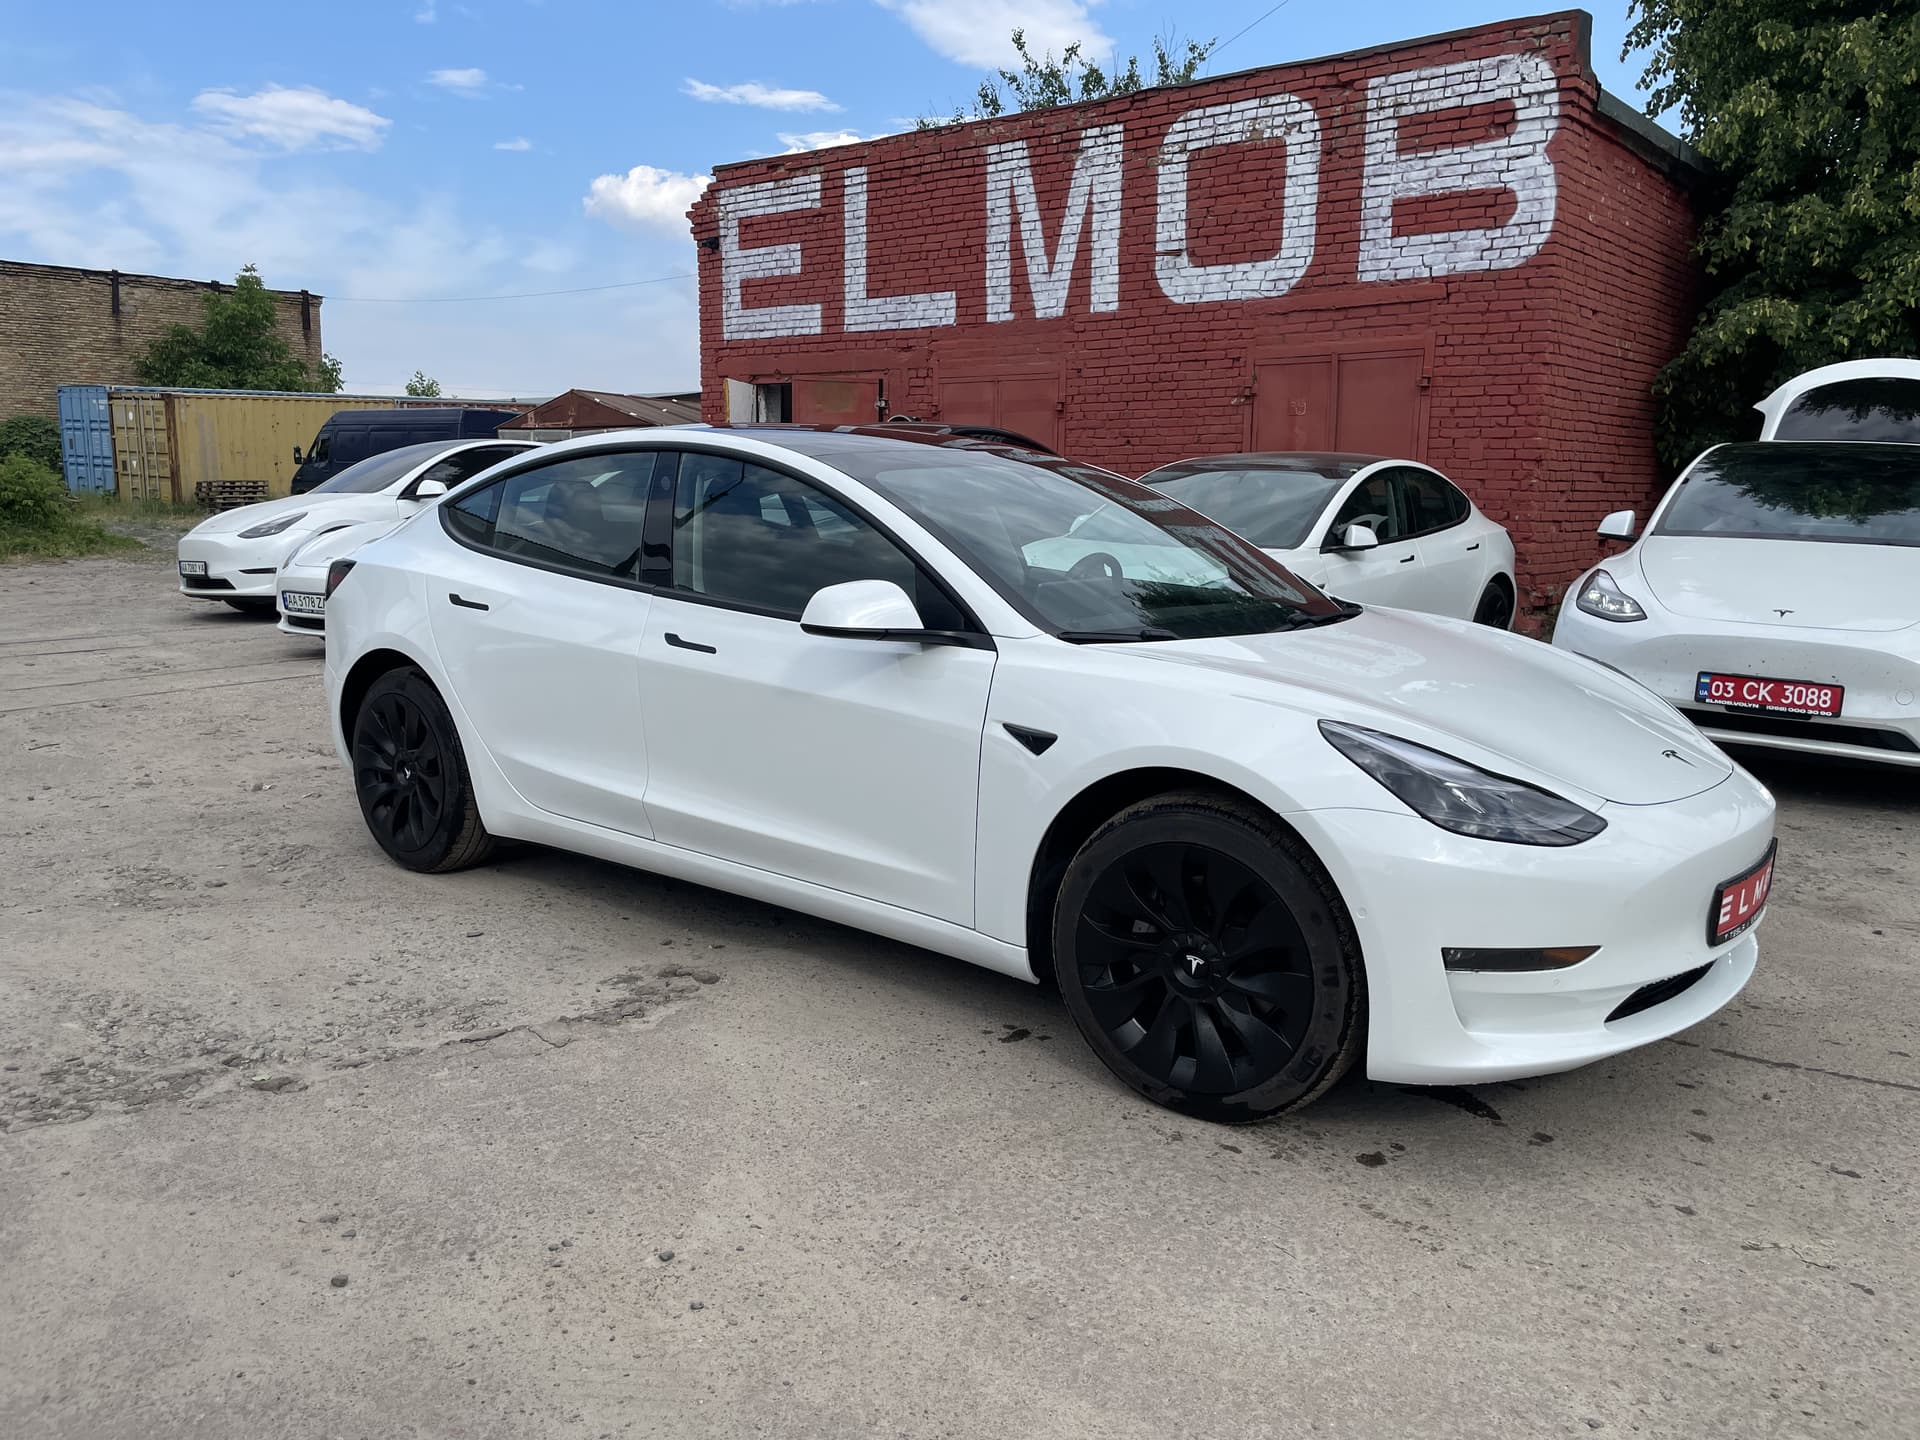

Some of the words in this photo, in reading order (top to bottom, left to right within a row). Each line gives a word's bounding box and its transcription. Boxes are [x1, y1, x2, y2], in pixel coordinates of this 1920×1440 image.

[716, 52, 1561, 341] ELMOB
[288, 594, 298, 607] AA
[298, 595, 315, 609] 5178
[1711, 681, 1735, 698] 03
[1743, 682, 1775, 702] CK
[1781, 685, 1832, 708] 3088
